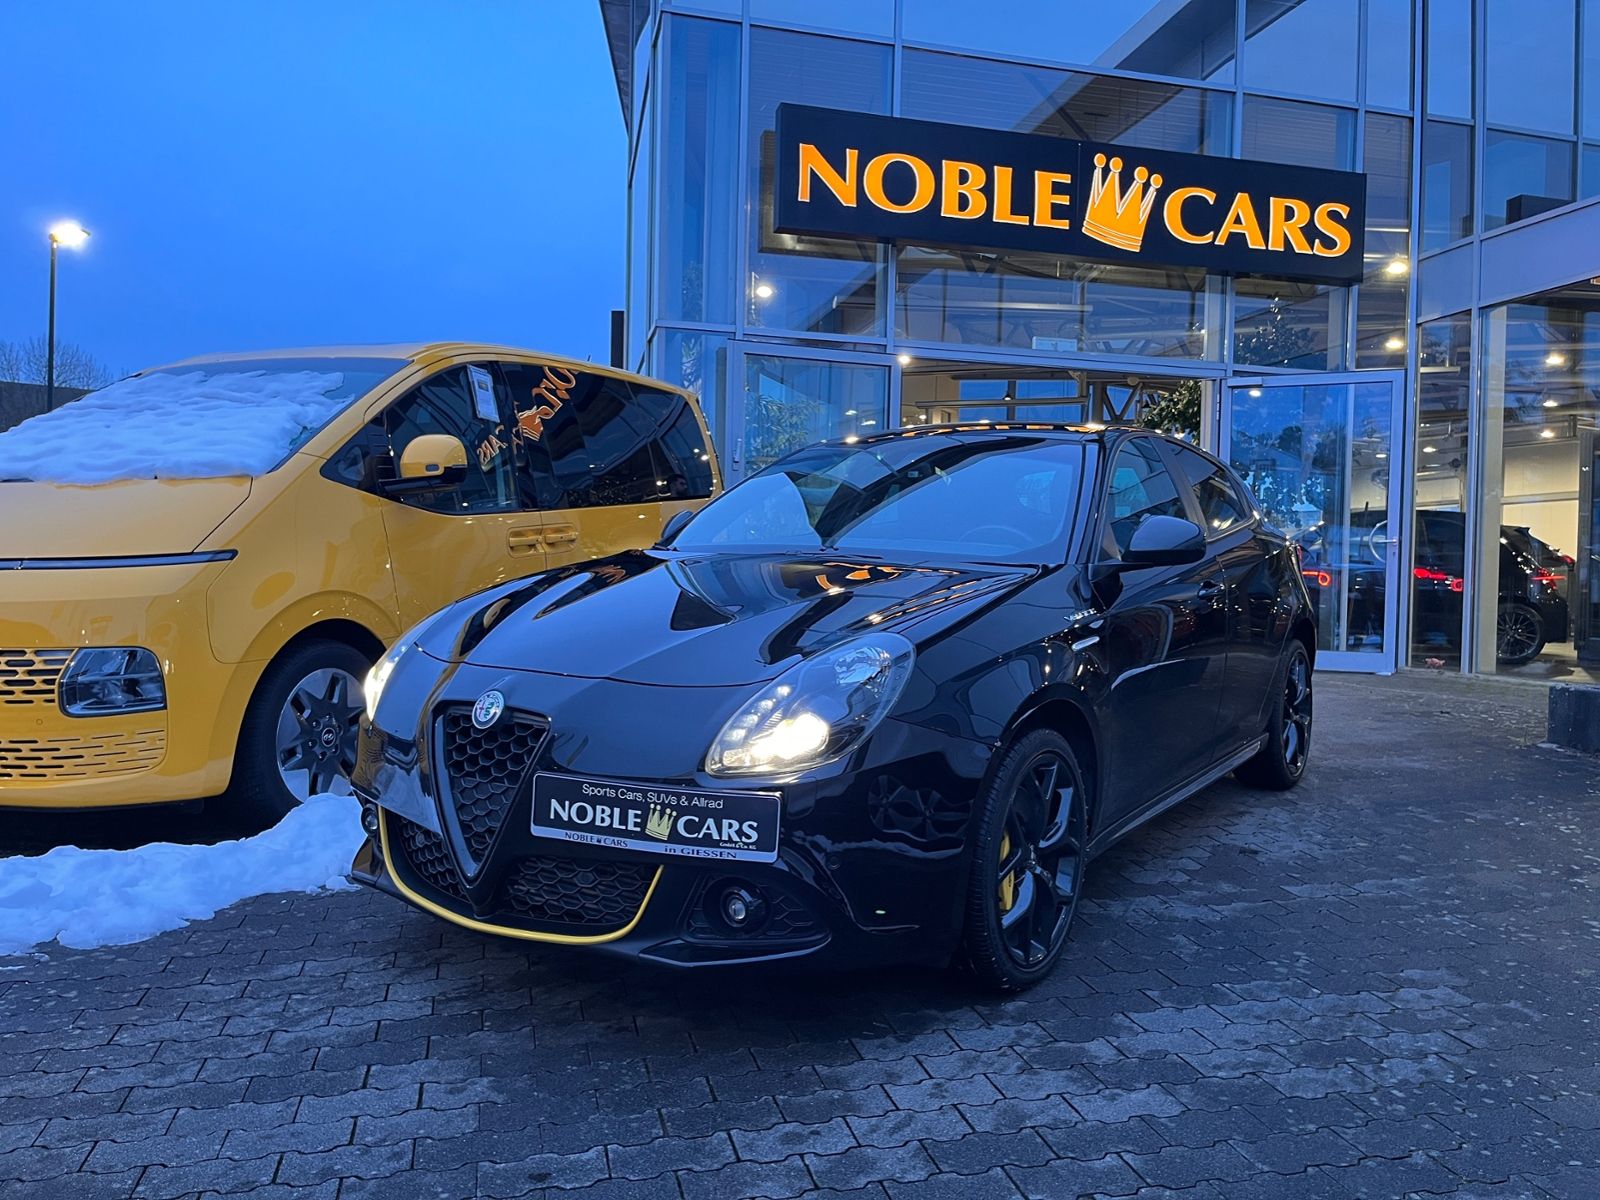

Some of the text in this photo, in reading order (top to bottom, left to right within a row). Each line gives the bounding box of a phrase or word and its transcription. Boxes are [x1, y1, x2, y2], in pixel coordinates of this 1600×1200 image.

[798, 143, 1352, 258] NOBLE CARS
[582, 783, 724, 809] Sports Cars, SUVs & Allrad
[550, 798, 758, 843] NOBLE CARS
[565, 832, 628, 847] NOBLE CARS
[681, 847, 737, 859] GIESSEN
